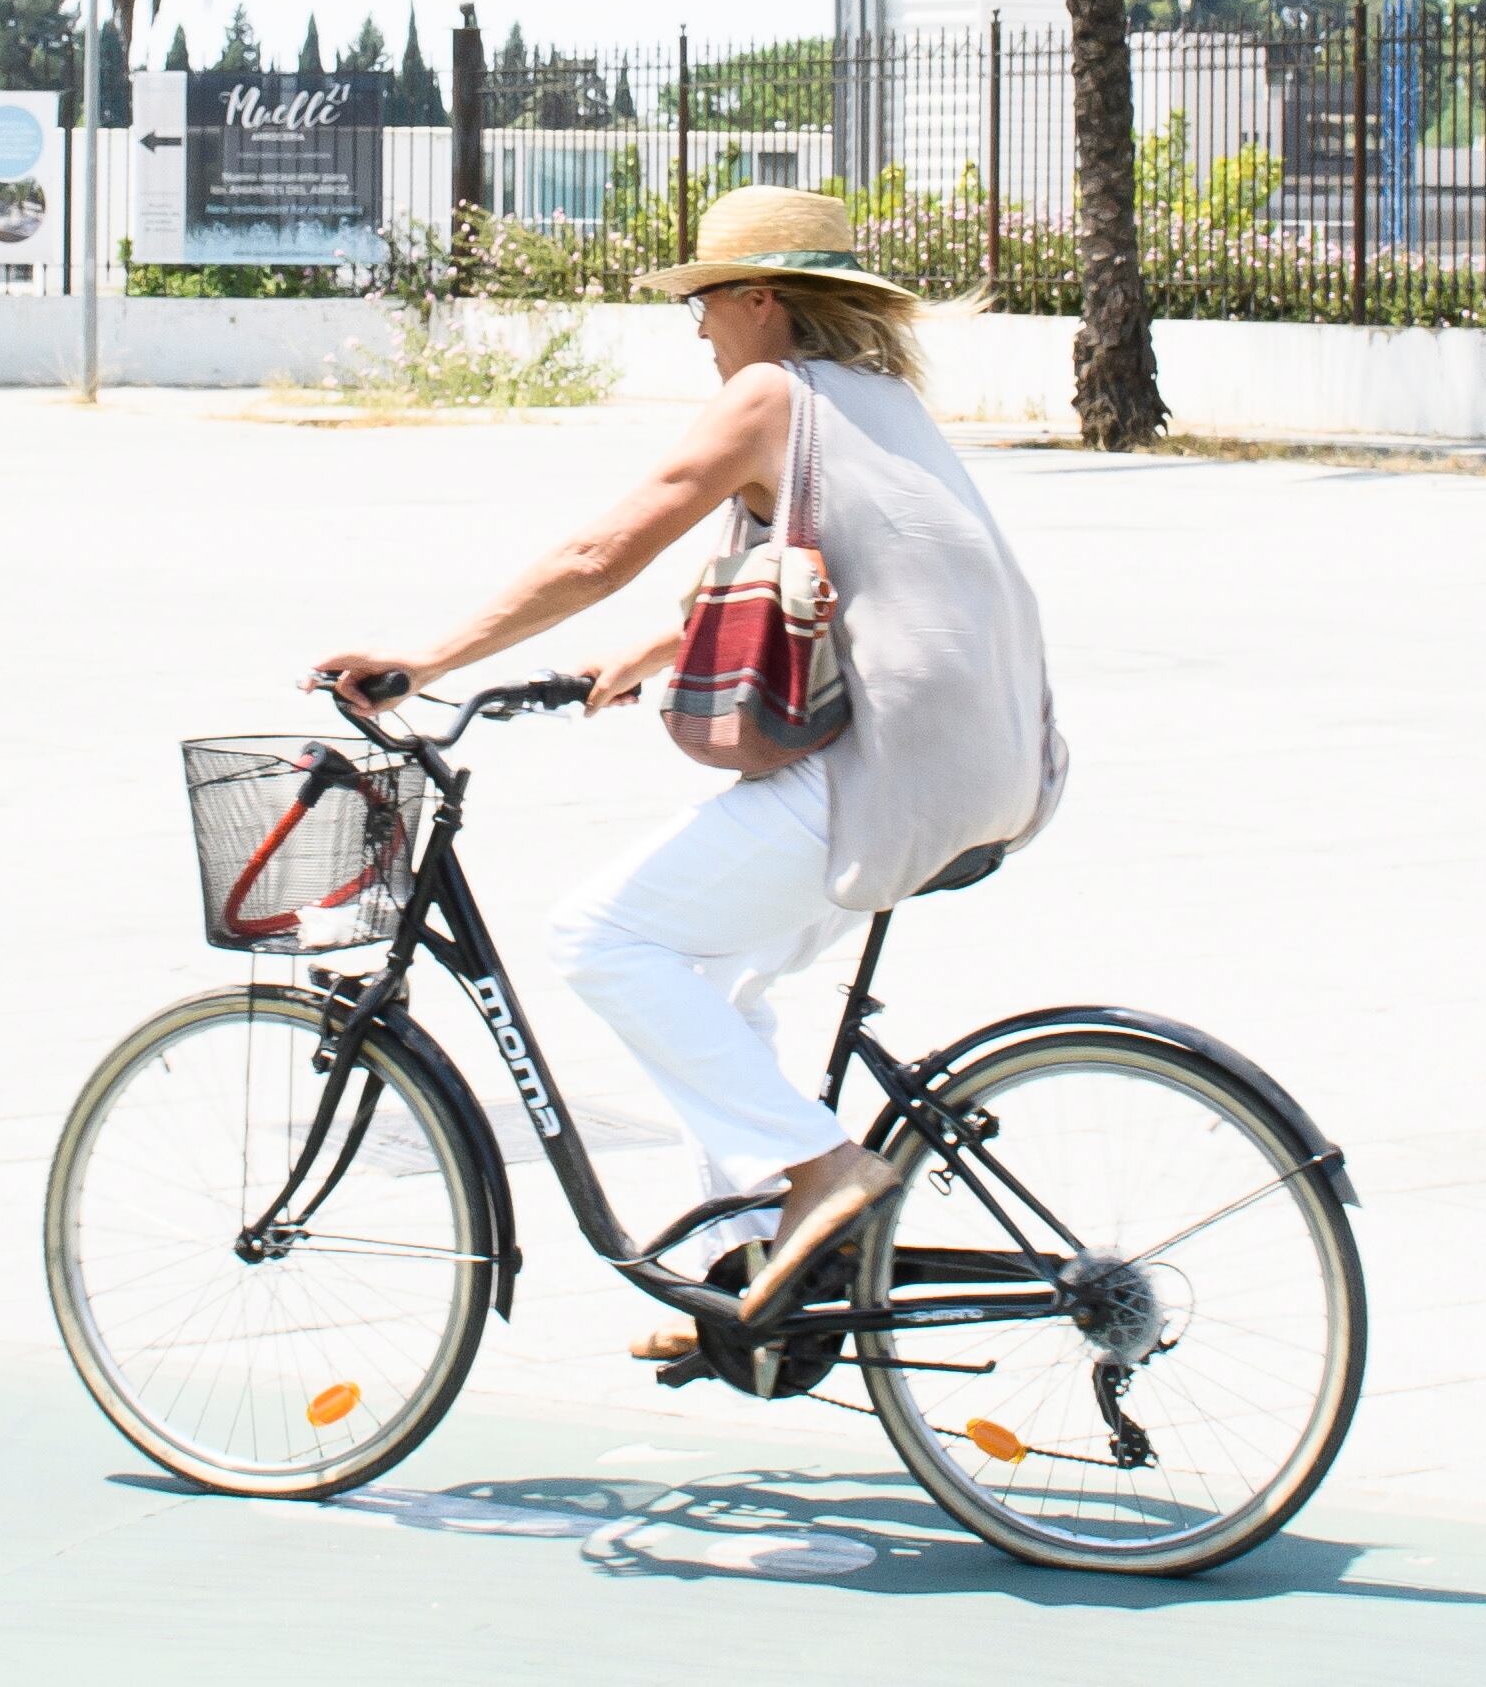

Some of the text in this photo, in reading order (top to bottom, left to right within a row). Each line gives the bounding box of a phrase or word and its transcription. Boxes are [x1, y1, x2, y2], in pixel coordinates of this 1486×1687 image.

[218, 82, 351, 130] Muelle 21
[475, 976, 562, 1138] moma
